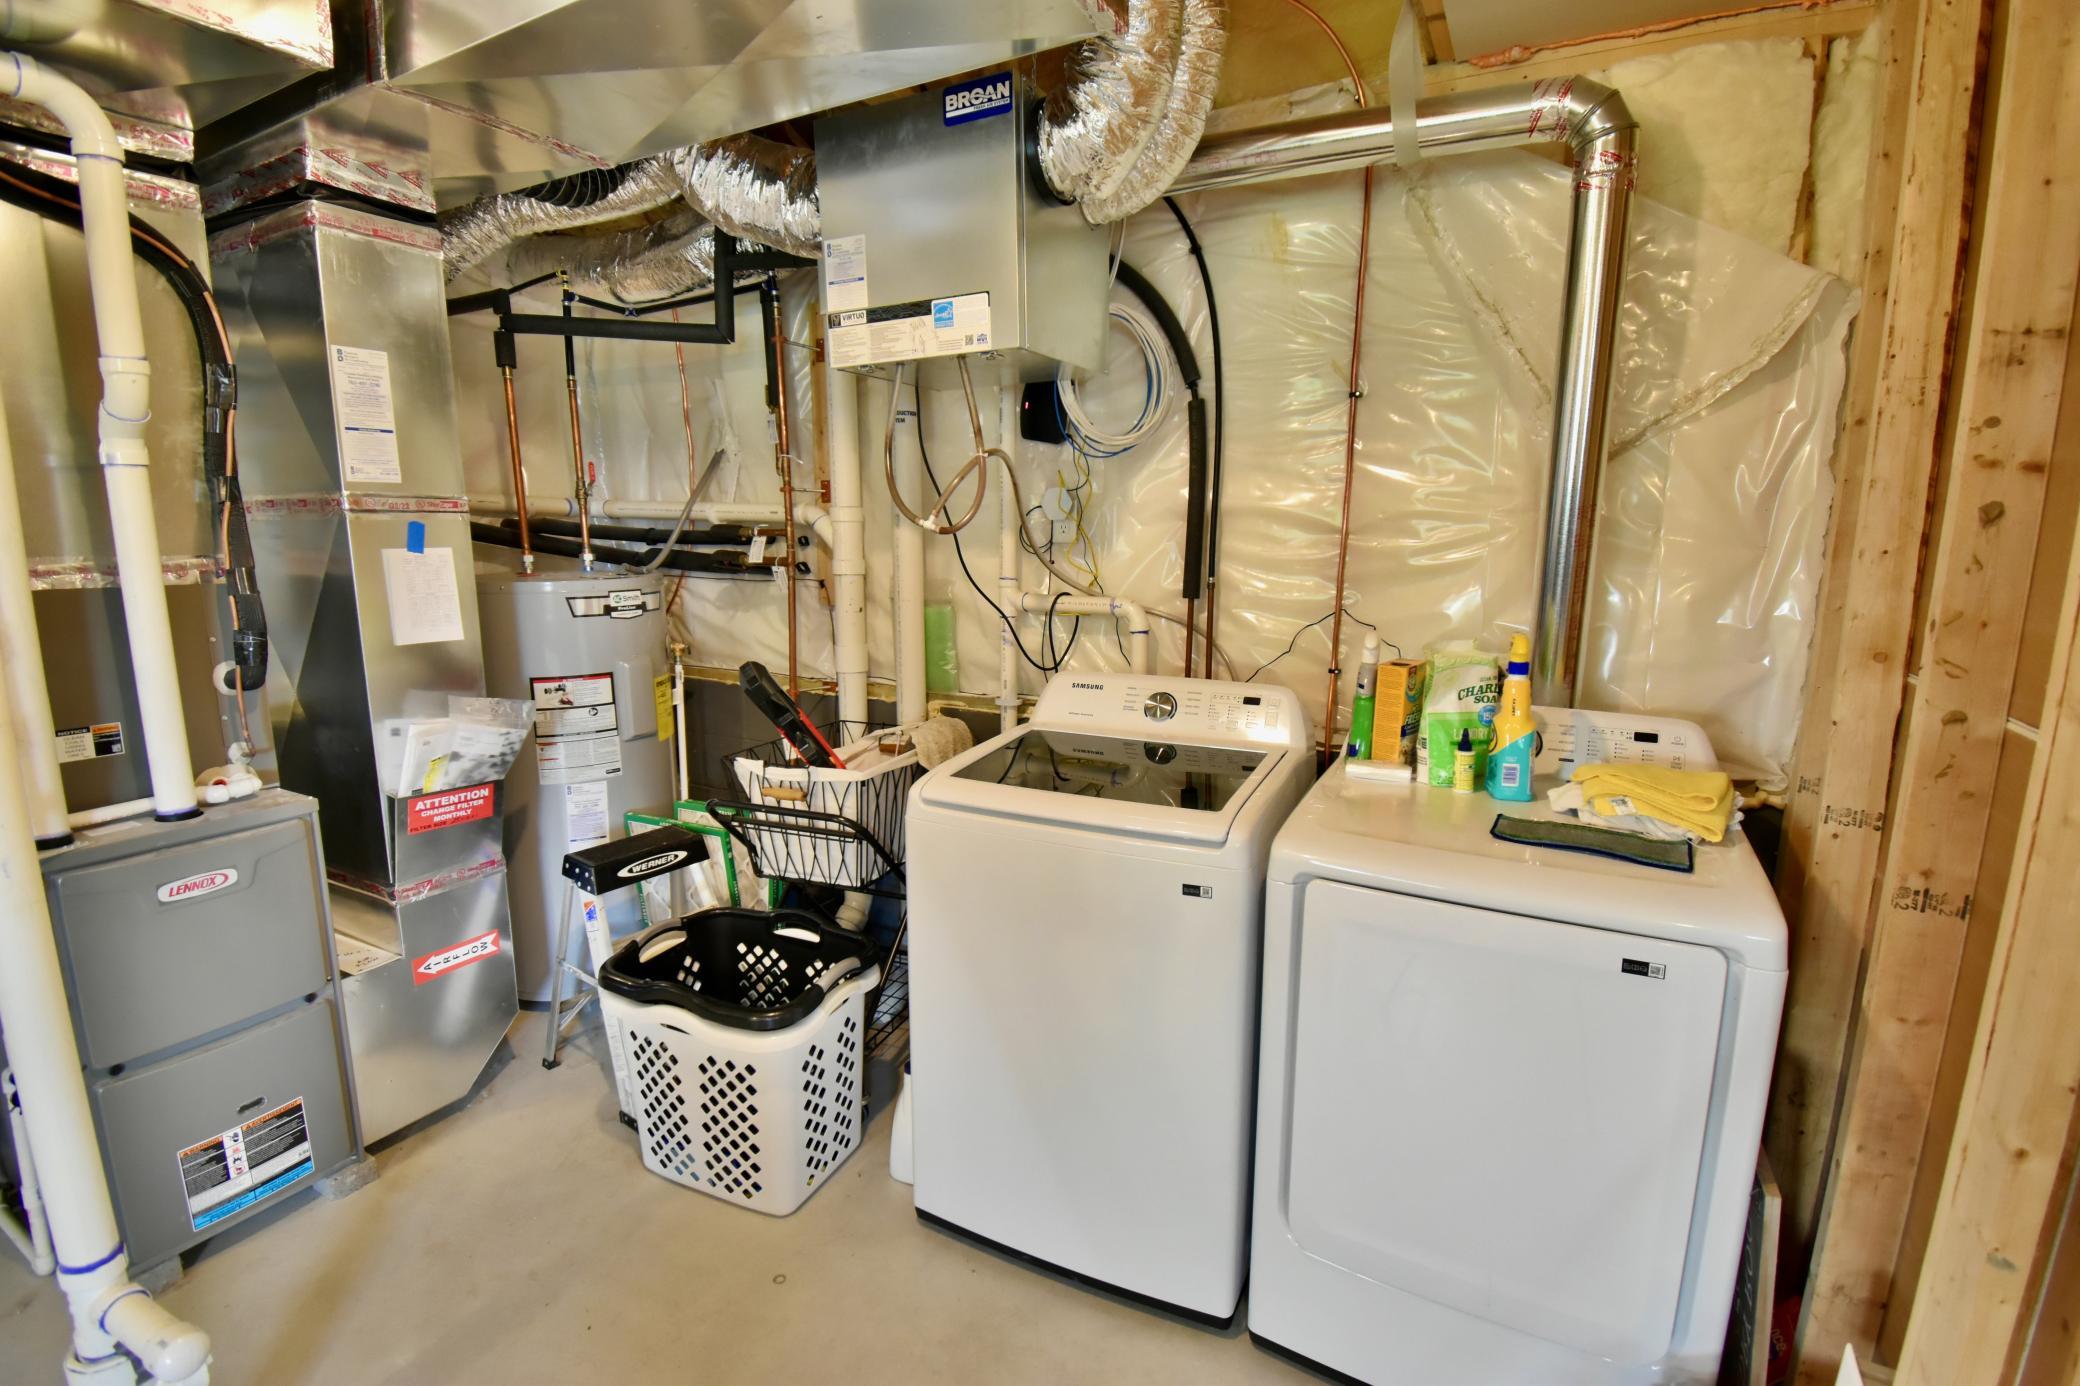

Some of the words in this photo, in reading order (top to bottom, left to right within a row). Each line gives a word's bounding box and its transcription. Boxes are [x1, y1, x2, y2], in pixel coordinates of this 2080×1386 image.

[945, 80, 1010, 112] BROAN
[842, 312, 865, 321] VIRTUO
[1072, 682, 1104, 690] SAMSUNG
[1457, 683, 1502, 701] CHARL
[1473, 695, 1498, 704] SOA
[415, 788, 489, 811] ATTENTION
[421, 805, 455, 817] CHANGE
[457, 799, 484, 809] FILTER
[433, 809, 472, 822] MONTHLY
[632, 854, 675, 873] WERNER
[169, 876, 217, 897] LENNOX
[424, 941, 488, 970] AIRFLOW
